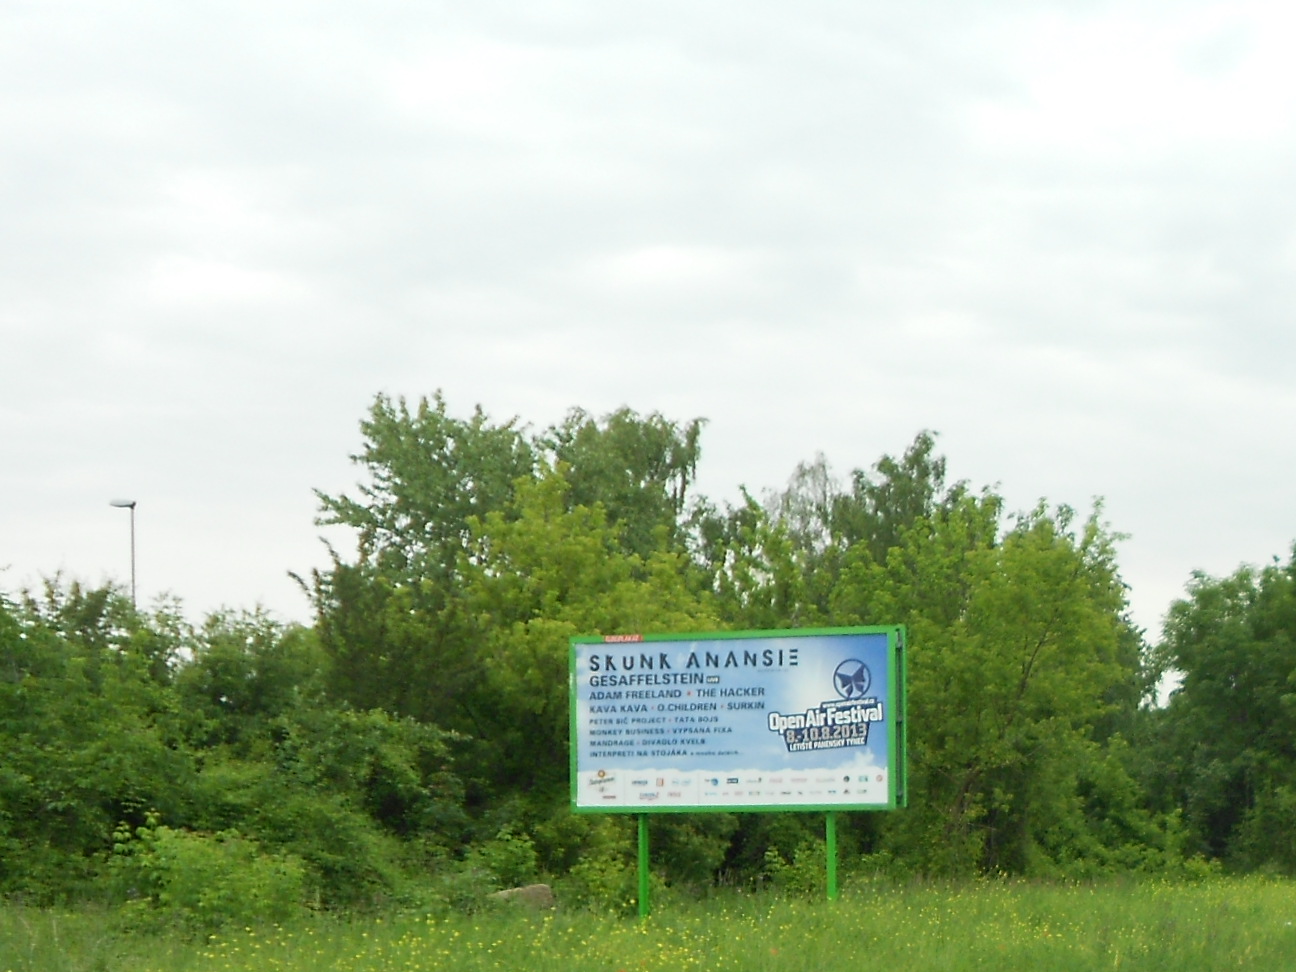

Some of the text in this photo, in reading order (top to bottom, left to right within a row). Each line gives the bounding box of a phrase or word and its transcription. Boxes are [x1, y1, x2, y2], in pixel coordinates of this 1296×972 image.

[589, 649, 798, 672] SKUNK ANANSIE
[590, 673, 704, 687] GESAFFELSTEIN
[589, 686, 765, 700] ADAM FREELAND THE HACKER
[589, 705, 617, 713] KAVA
[620, 704, 648, 712] KAVA
[727, 701, 765, 710] SURKIN
[769, 712, 805, 734] Open
[805, 709, 827, 728] Air
[827, 702, 883, 726] Festival
